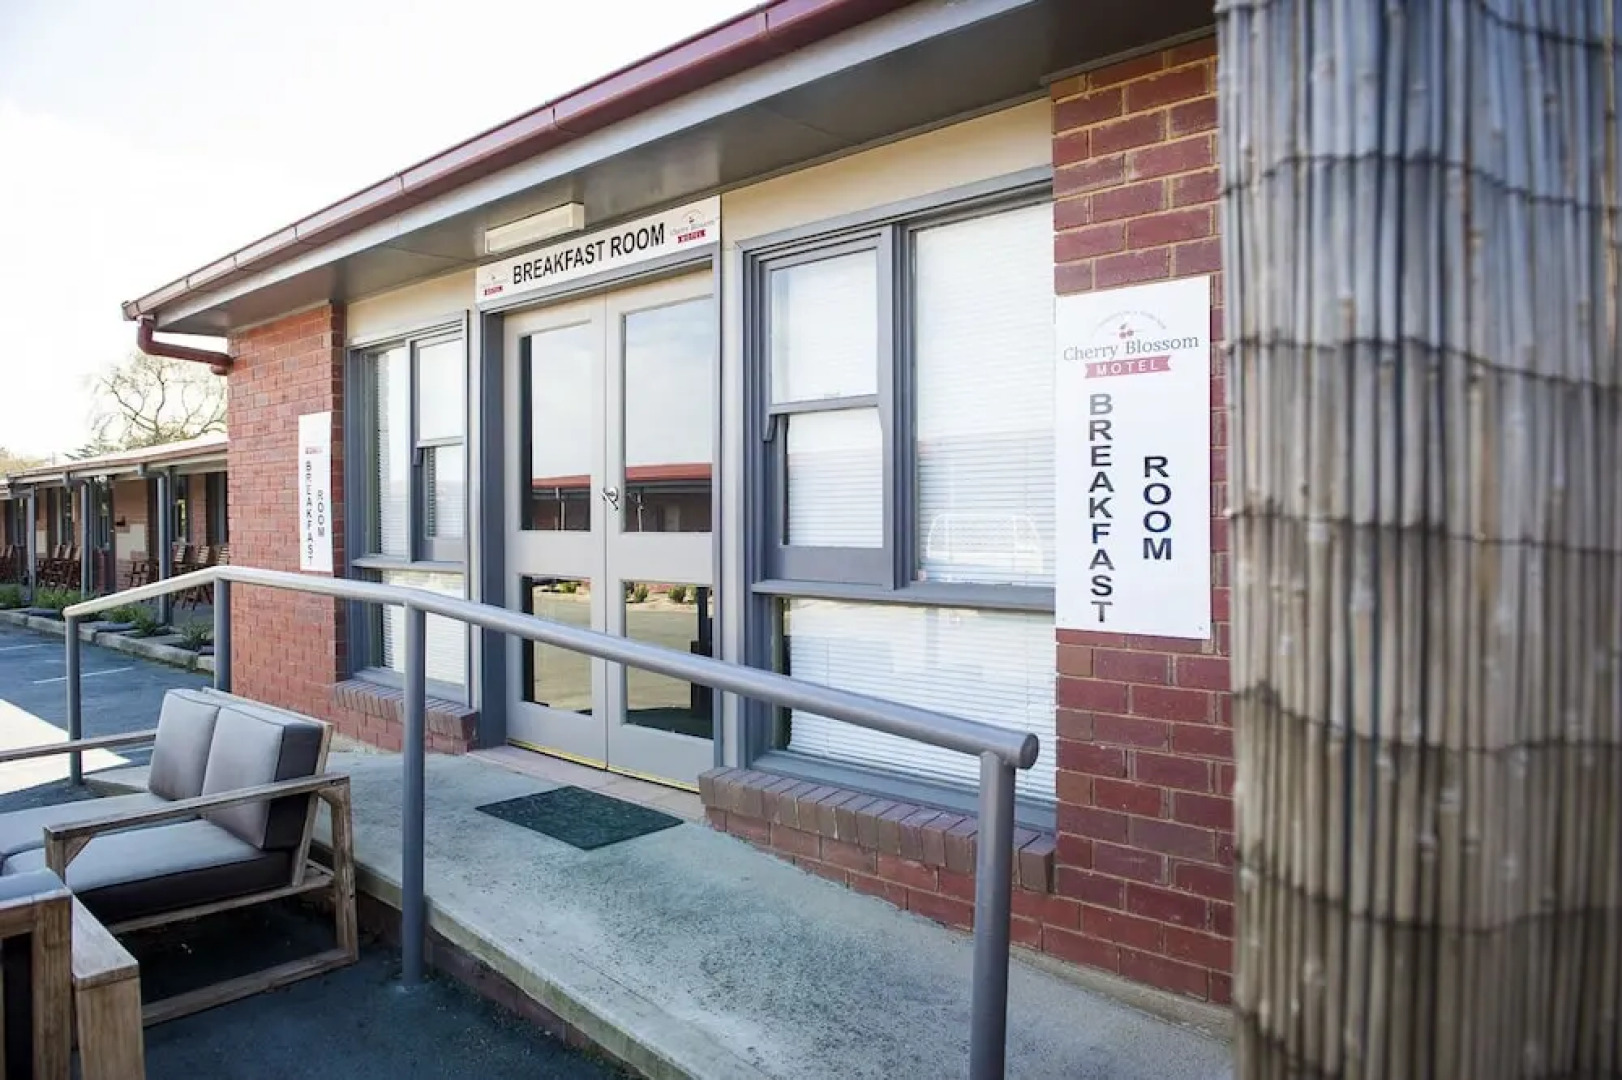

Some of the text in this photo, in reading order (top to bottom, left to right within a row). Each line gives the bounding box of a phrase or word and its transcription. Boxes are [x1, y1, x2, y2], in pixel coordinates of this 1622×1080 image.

[513, 240, 606, 285] BREAKFAST
[610, 222, 665, 259] ROOM
[1063, 336, 1200, 361] Cherry Blossom
[1095, 359, 1159, 377] MOTEL
[304, 460, 314, 566] BREAKFAST
[317, 489, 326, 538] ROOM
[1088, 393, 1115, 623] BREAKFAST
[1142, 455, 1172, 561] ROOM
